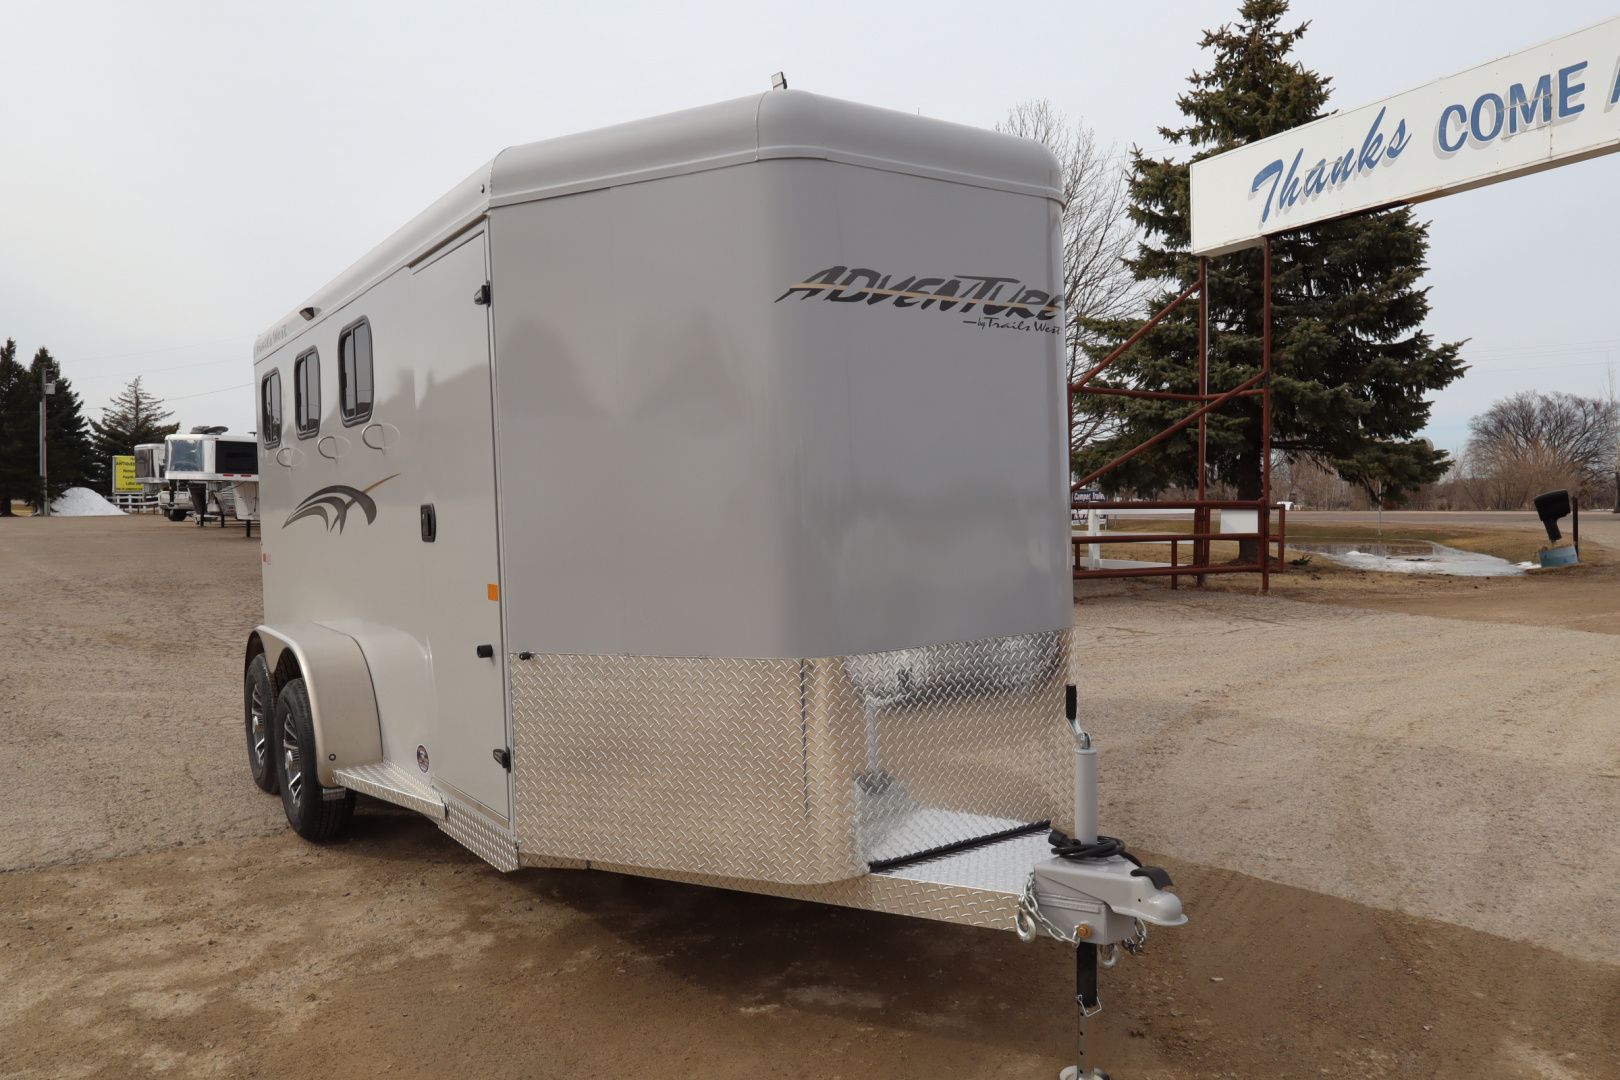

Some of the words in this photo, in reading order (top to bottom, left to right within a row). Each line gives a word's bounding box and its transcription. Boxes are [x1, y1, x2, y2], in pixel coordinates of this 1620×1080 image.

[1251, 106, 1412, 223] Thanks
[1438, 61, 1588, 152] COME
[774, 266, 1063, 320] ADVENTURE
[984, 316, 1031, 331] Trails
[1034, 321, 1062, 335] West
